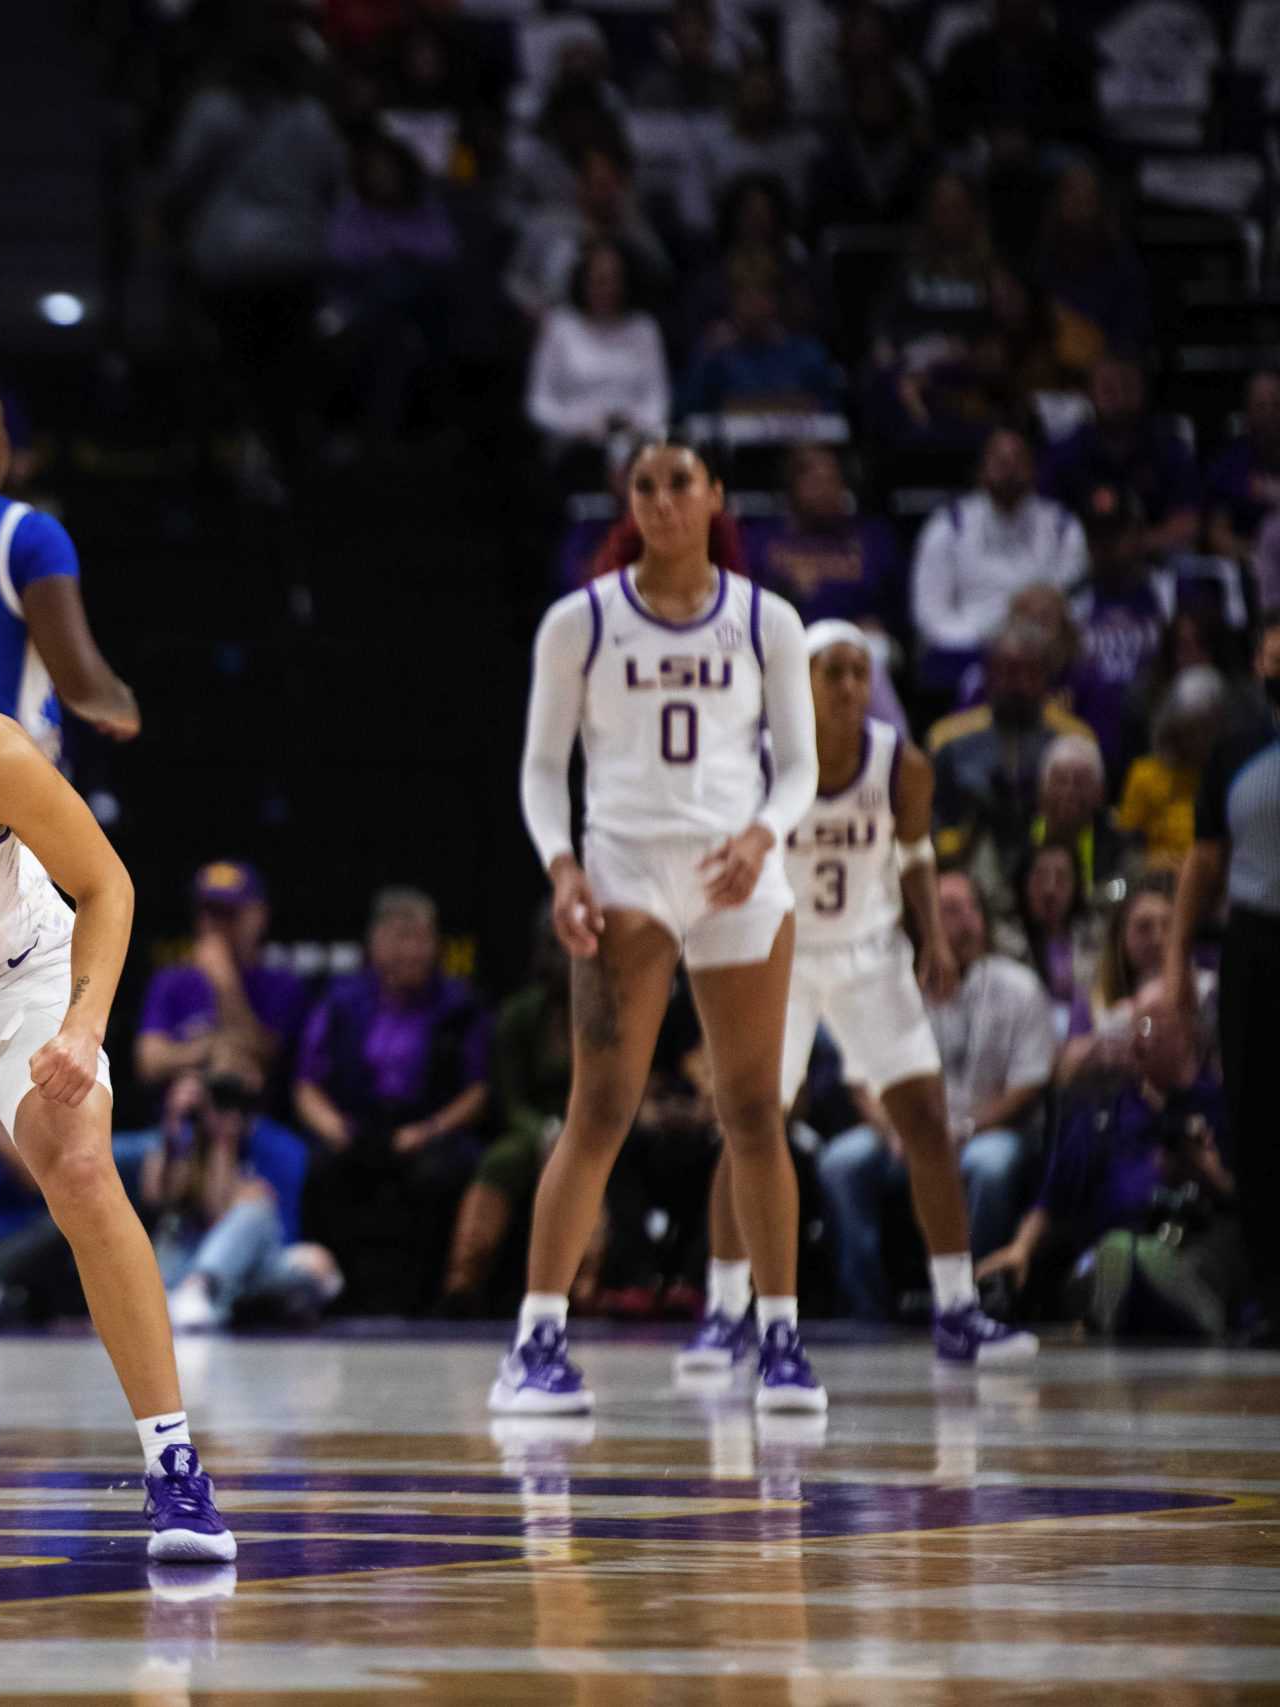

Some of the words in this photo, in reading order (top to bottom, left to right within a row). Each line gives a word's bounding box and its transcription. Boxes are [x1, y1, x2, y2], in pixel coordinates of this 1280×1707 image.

[625, 655, 733, 690] LSU
[660, 700, 699, 766] 0
[785, 820, 877, 853] LSU
[814, 860, 847, 915] 3
